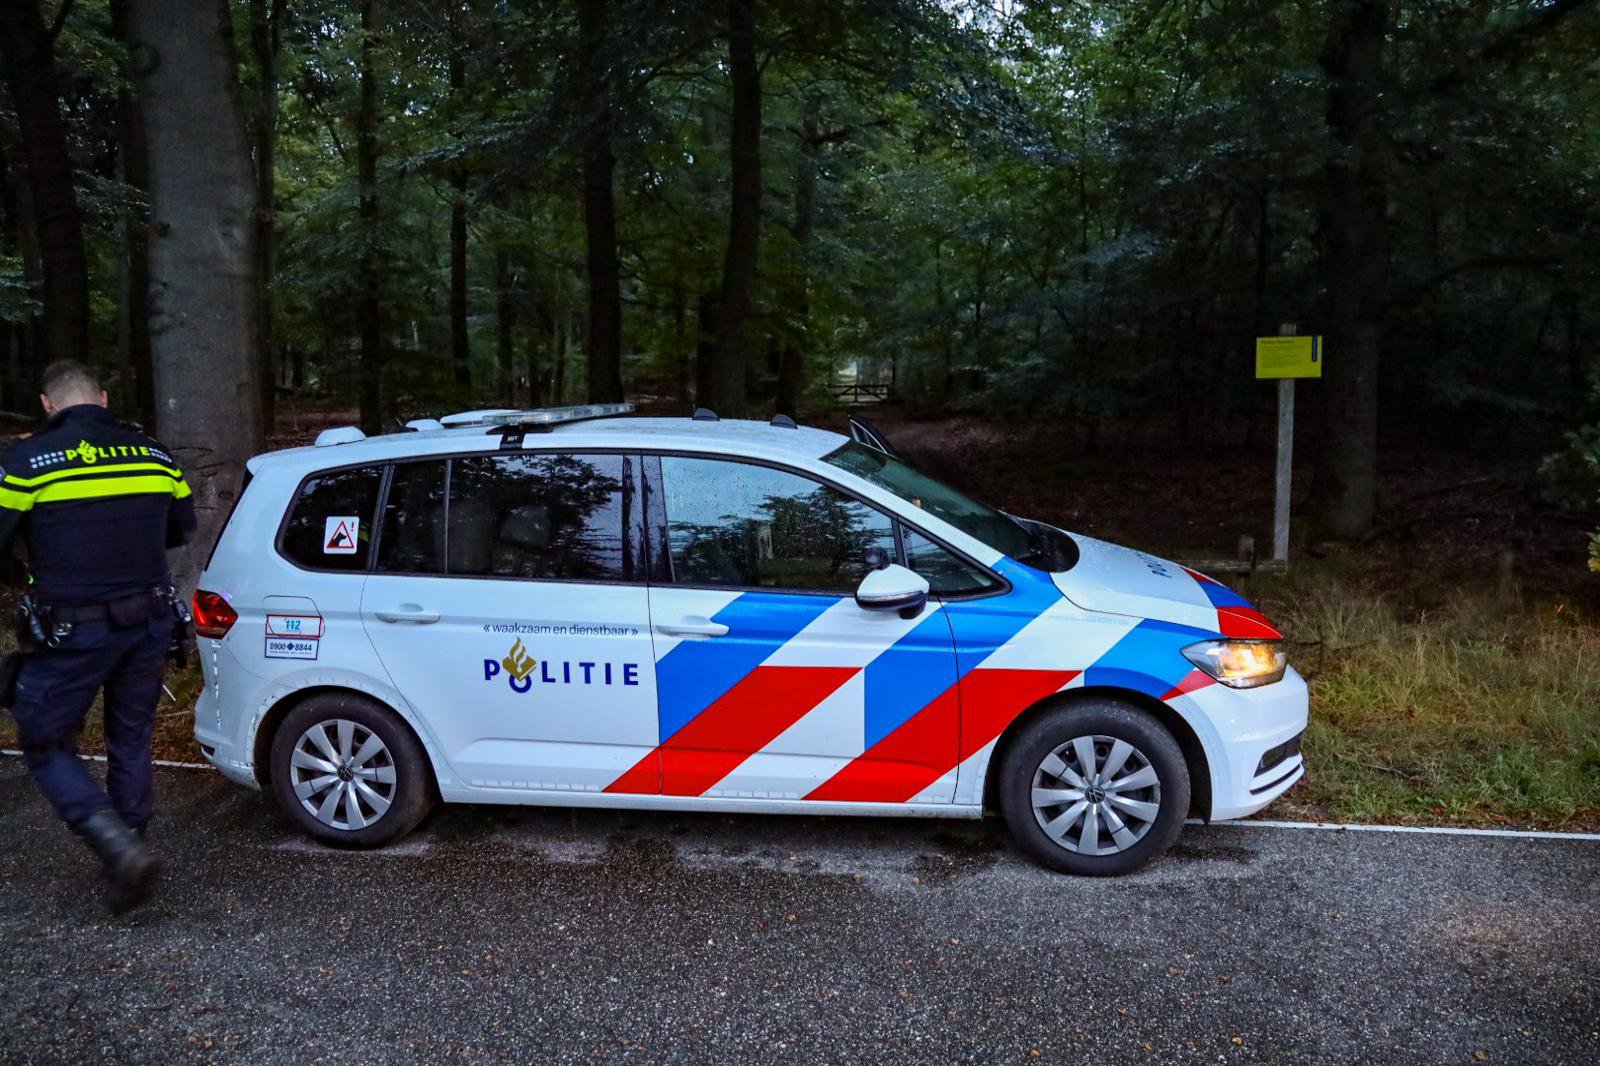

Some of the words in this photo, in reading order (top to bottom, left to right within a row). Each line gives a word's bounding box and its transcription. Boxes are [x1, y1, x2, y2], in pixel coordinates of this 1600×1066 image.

[65, 445, 150, 464] POLITIE
[286, 619, 301, 630] 112
[492, 622, 550, 634] waakzaam
[553, 626, 567, 635] en
[569, 624, 628, 636] dienstbaar
[270, 642, 286, 651] 0900
[295, 643, 312, 651] 8844
[483, 659, 639, 694] POLITIE
